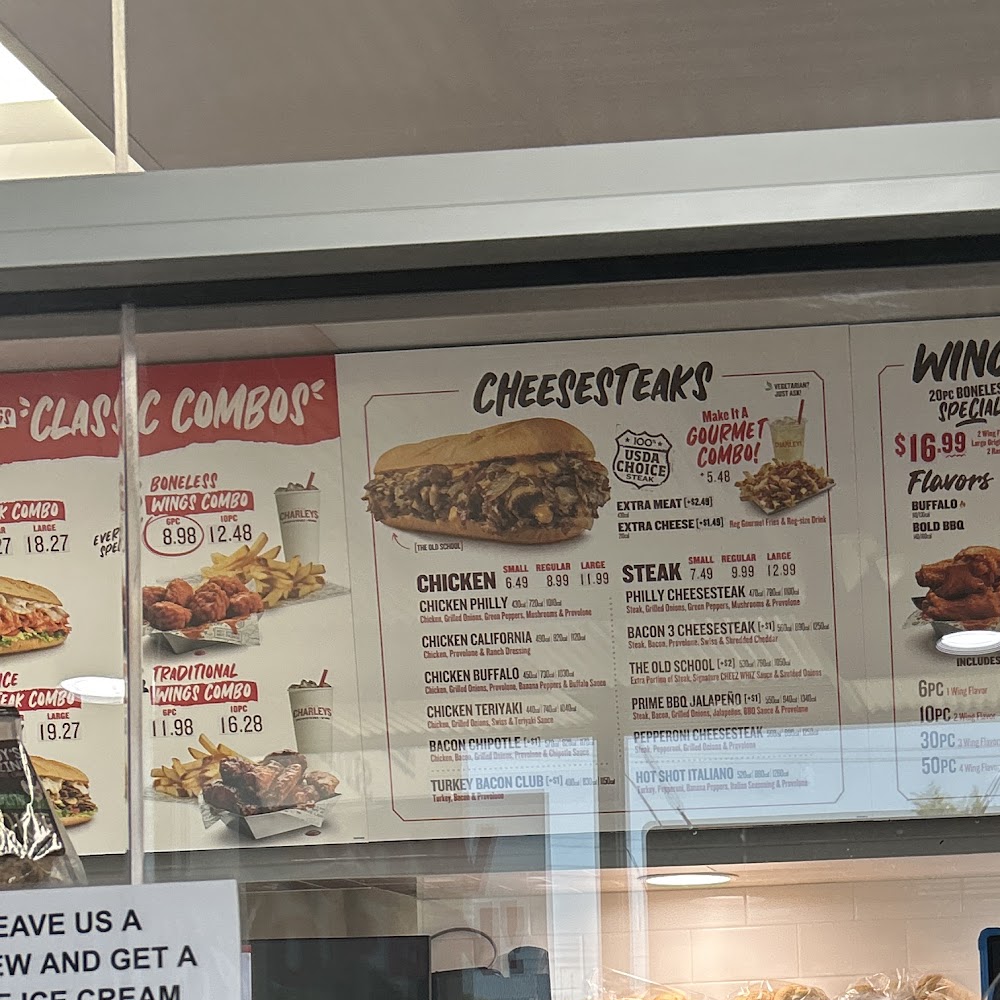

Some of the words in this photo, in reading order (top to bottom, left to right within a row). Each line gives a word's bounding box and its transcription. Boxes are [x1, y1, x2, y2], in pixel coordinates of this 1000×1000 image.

[473, 361, 713, 416] CHEESESTEAKS
[171, 382, 308, 433] COMBOS
[702, 410, 729, 422] Make
[731, 408, 740, 420] It
[741, 407, 748, 418] A
[687, 418, 768, 446] GOURMET
[625, 450, 660, 464] USDA
[697, 442, 761, 468] COMBO!
[617, 461, 666, 477] CHOICE
[626, 474, 654, 482] STEAK
[150, 472, 218, 492] BONELESS
[907, 469, 994, 494] Flavors
[12, 502, 58, 520] COMBO
[151, 495, 195, 512] WINGS
[201, 493, 248, 511] COMBO
[617, 501, 650, 511] EXTRA
[654, 499, 682, 509] MEAT
[912, 499, 957, 511] BUFFALO
[163, 527, 196, 545] 8.98
[209, 524, 251, 543] 12.48
[27, 535, 68, 553] 18.27
[417, 572, 496, 592] CHICKEN
[506, 576, 528, 589] 6.49
[547, 575, 568, 587] 8.99
[580, 573, 609, 585] 11.99
[622, 563, 681, 583] STEAK
[690, 568, 713, 580] 7.49
[731, 566, 754, 578] 9.99
[767, 564, 796, 576] 12.99
[626, 589, 664, 603] PHILLY
[668, 585, 745, 601] CHEESESTEAK
[420, 599, 467, 613] CHICKEN
[470, 597, 508, 610] PHILLY
[628, 625, 665, 638] BACON
[668, 624, 674, 636] 3
[678, 621, 755, 636] CHEESESTEAK
[422, 634, 467, 648] CHICKEN
[471, 631, 532, 645] CALIFORNIA
[153, 662, 238, 682] TRADITIONAL
[427, 704, 473, 718] CHICKEN
[475, 702, 522, 716] TERIYAKI
[40, 722, 80, 740] 19.27
[152, 719, 193, 737] 11.98
[220, 715, 262, 734] 16.28
[75, 910, 112, 934] US
[122, 909, 142, 931] A
[41, 951, 100, 974] AND
[111, 946, 168, 971] GET
[178, 945, 197, 967] A
